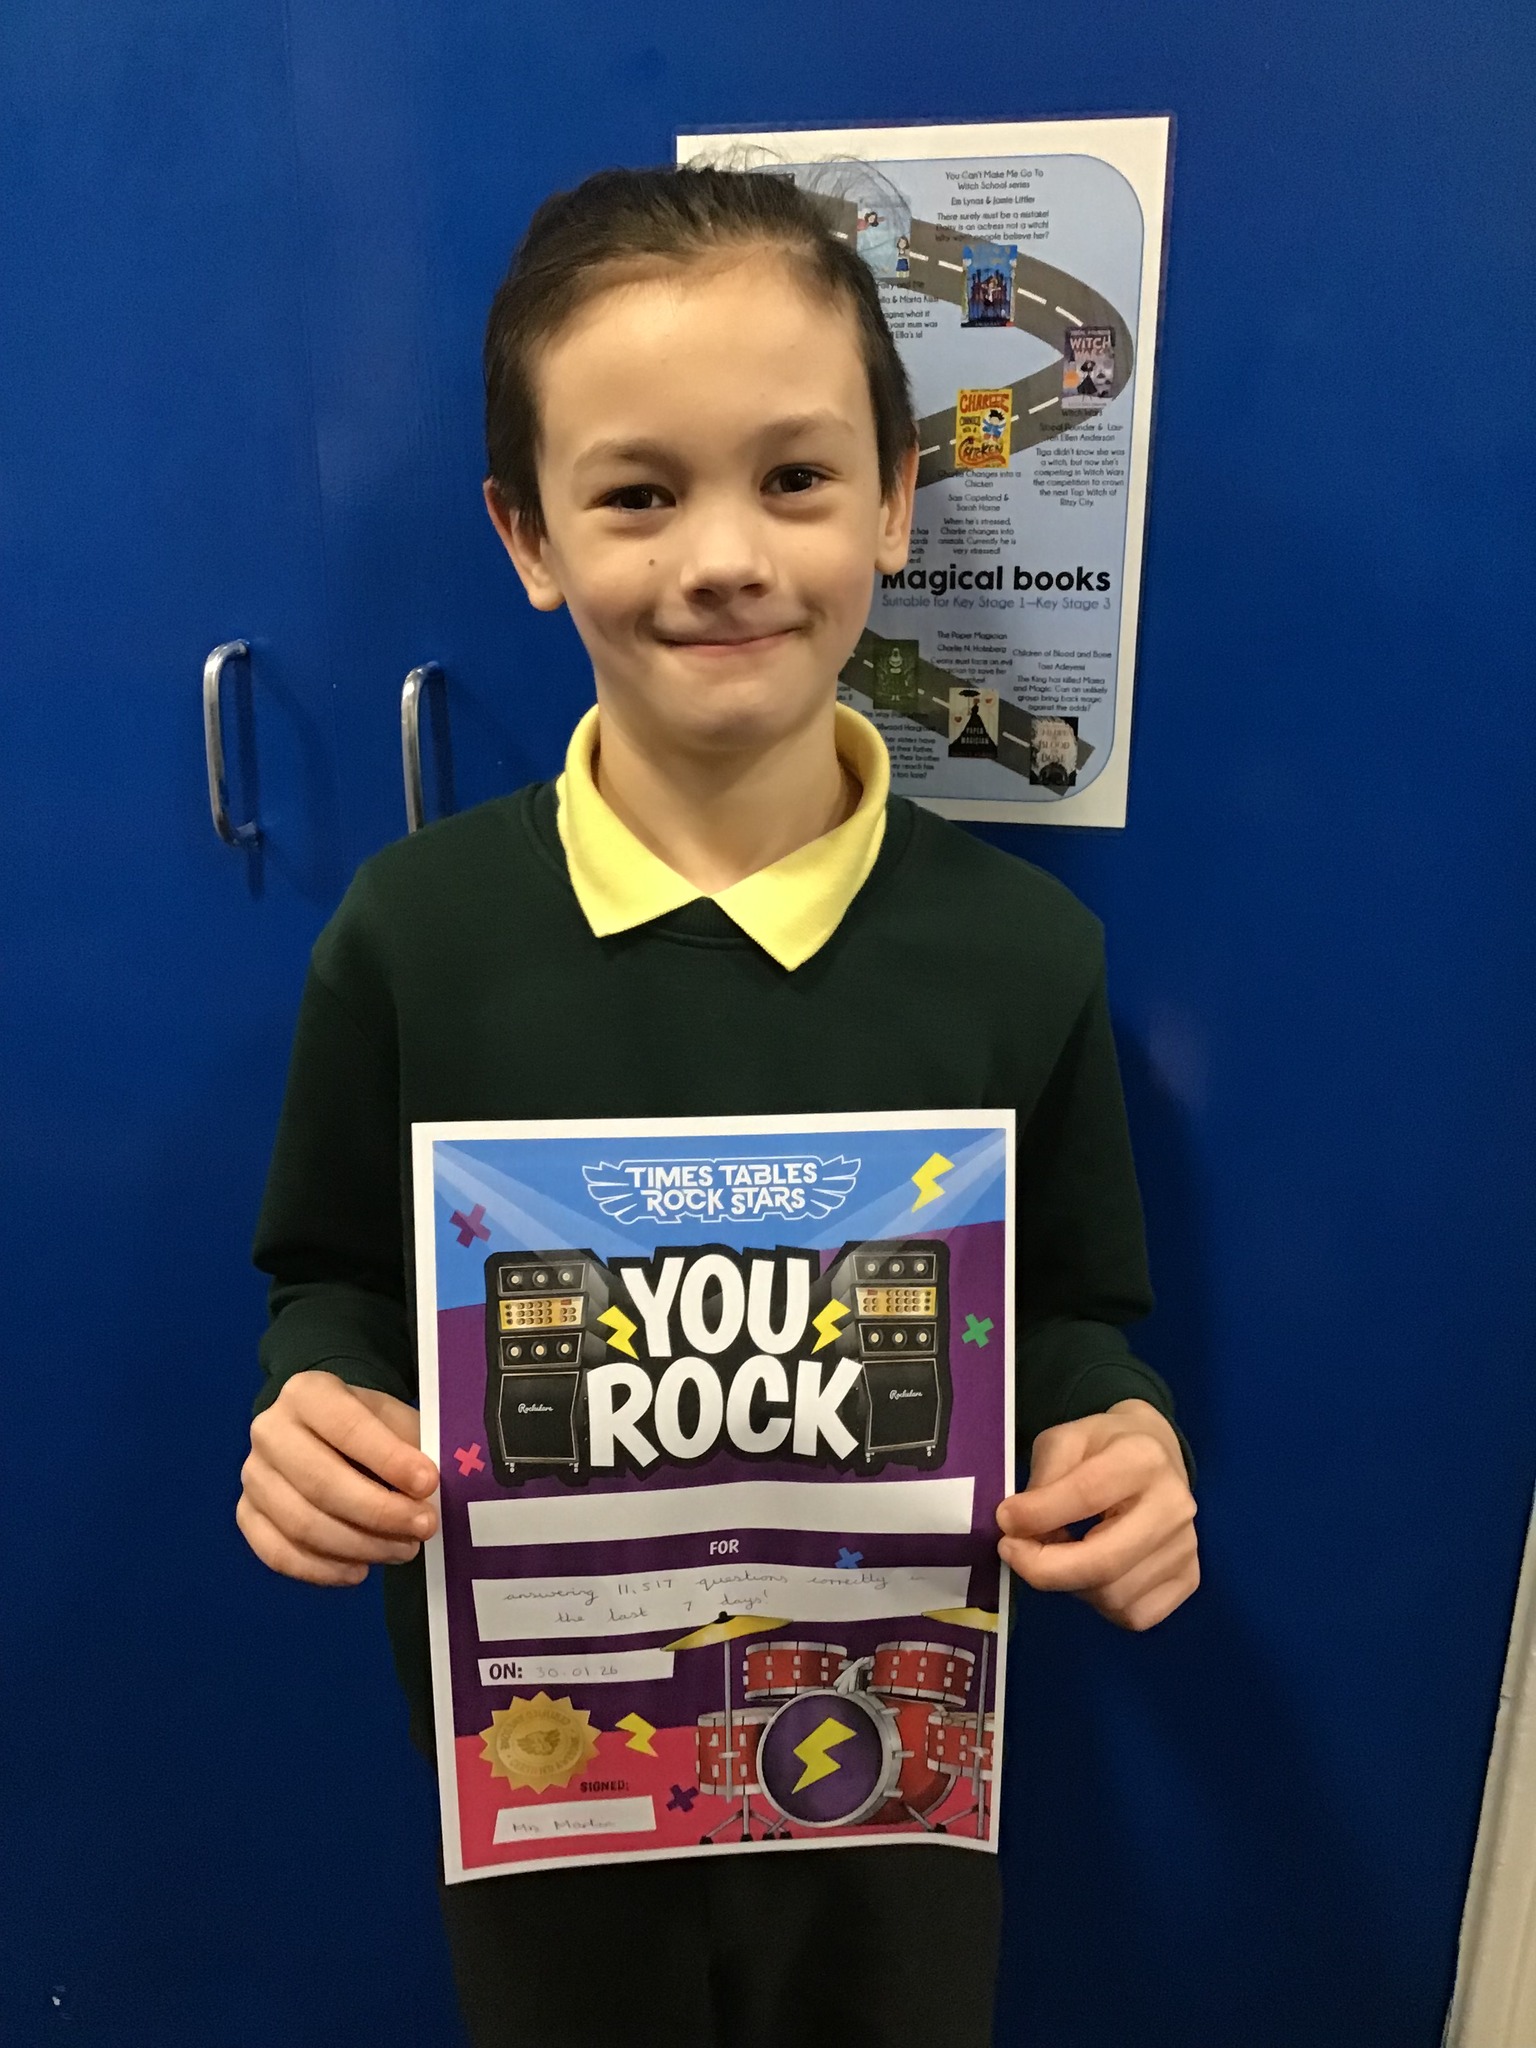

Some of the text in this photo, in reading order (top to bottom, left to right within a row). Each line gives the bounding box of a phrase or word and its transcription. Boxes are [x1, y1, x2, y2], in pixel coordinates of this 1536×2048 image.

[945, 169, 1044, 180] You Can't Make Me Go To
[958, 182, 979, 190] Witch
[981, 181, 1007, 190] School
[964, 197, 983, 206] Lynas
[986, 196, 991, 204] &
[960, 212, 980, 220] surely
[1000, 211, 1011, 219] be
[1003, 232, 1049, 240] believe her?
[906, 310, 923, 318] what
[896, 331, 913, 339] Ella's
[1070, 335, 1111, 349] WITCH
[1098, 423, 1103, 431] &
[966, 471, 998, 479] Changes
[965, 480, 993, 488] Chicken
[1071, 488, 1084, 496] Top
[1087, 488, 1107, 496] Witch
[965, 494, 1002, 502] Copeland
[957, 504, 977, 512] Sarah
[941, 527, 966, 535] Charlie
[968, 528, 999, 536] changes
[967, 537, 998, 546] Currently
[881, 564, 1111, 596] Magical books
[882, 595, 930, 609] Suitable
[934, 595, 949, 608] for
[954, 596, 974, 610] Key
[978, 596, 1014, 610] Stage
[1062, 597, 1099, 612] Stage
[1103, 597, 1111, 610] 3
[938, 631, 1007, 640] The Paper Magician
[937, 644, 962, 652] Charlie
[1013, 649, 1042, 657] Children
[1053, 650, 1075, 658] Blood
[1018, 675, 1030, 683] The
[1032, 676, 1047, 684] King
[625, 1163, 817, 1190] TIMES TABLES
[640, 1187, 805, 1216] ROCK STARS
[620, 1254, 810, 1357] YOU
[587, 1355, 863, 1467] ROCK
[709, 1539, 739, 1555] FOR
[504, 1588, 598, 1606] answering
[696, 1571, 787, 1591] questions
[808, 1574, 888, 1590] correctly
[555, 1589, 768, 1623] the last 7 days!
[490, 1662, 523, 1680] ON:
[580, 1781, 629, 1793] SIGNED:
